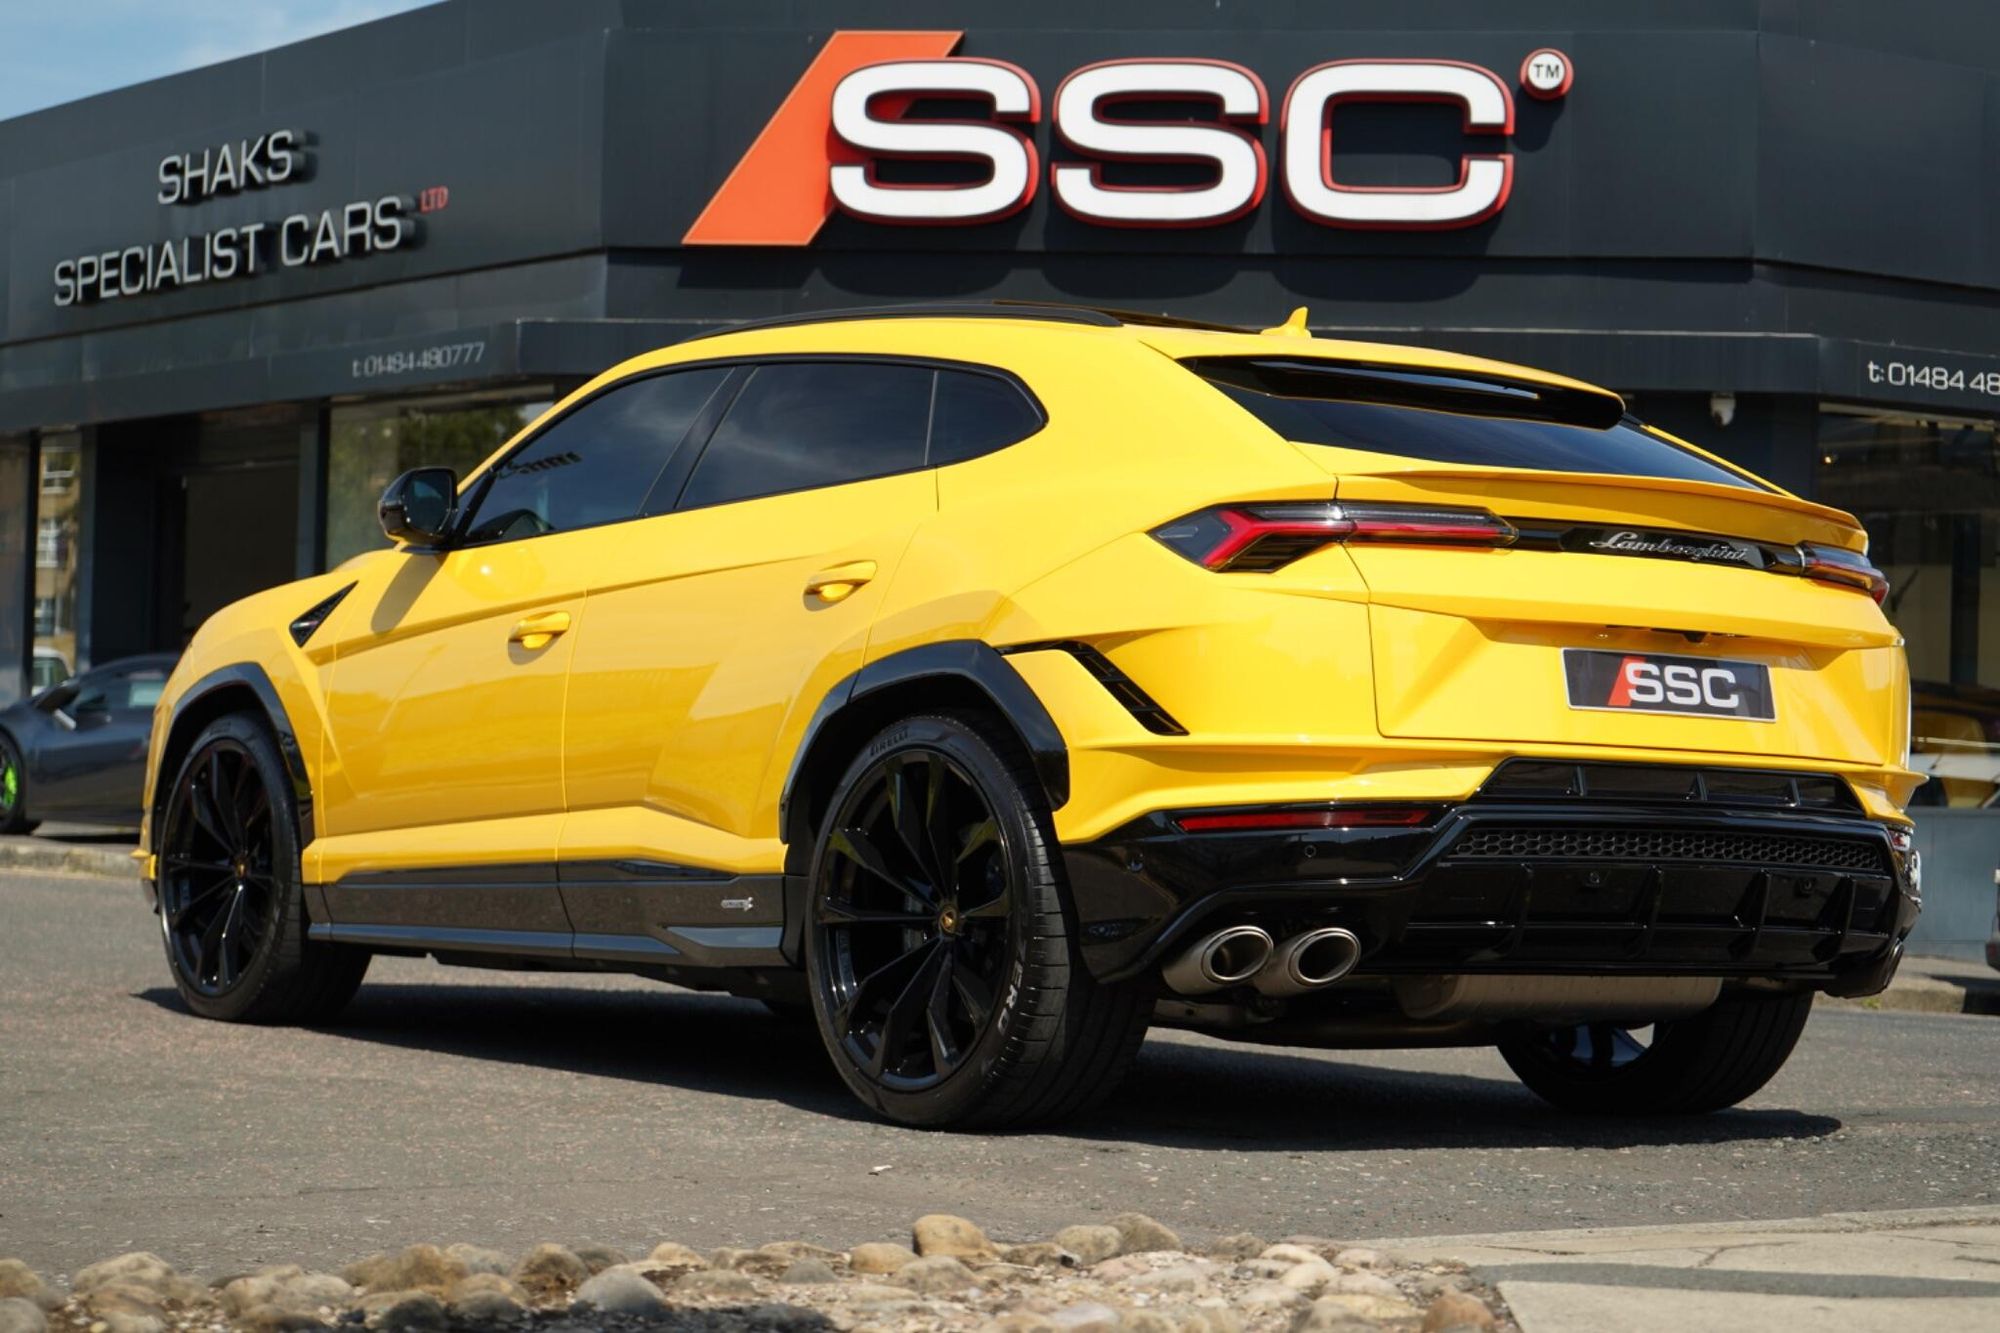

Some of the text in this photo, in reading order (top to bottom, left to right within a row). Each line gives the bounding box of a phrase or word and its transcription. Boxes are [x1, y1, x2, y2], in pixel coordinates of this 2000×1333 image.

[158, 129, 294, 204] SHAKS
[830, 58, 1560, 226] SSC TM
[54, 185, 449, 306] SPECIALIST CARS LTD
[1625, 662, 1740, 709] SSC
